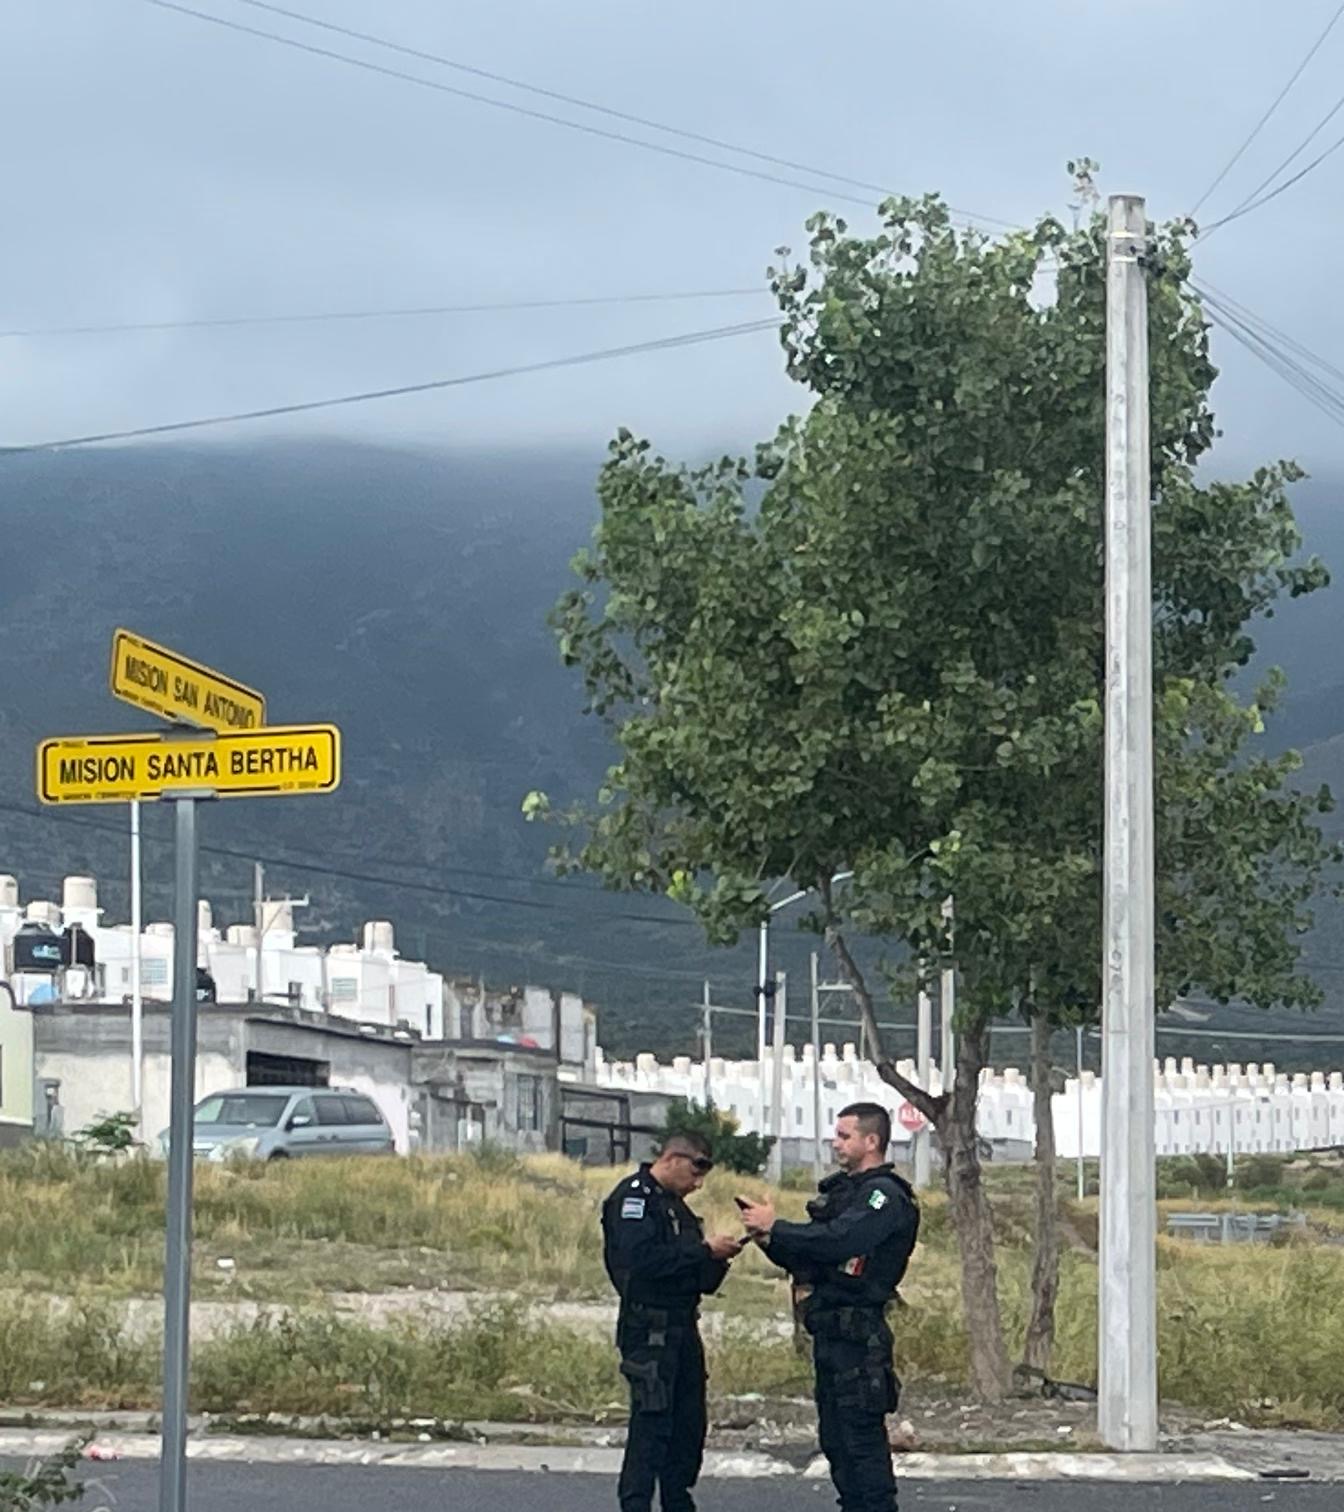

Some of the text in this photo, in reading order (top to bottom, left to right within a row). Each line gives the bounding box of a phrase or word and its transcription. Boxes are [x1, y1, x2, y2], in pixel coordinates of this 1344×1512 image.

[125, 655, 168, 695] MISION
[174, 676, 199, 708] SAN
[60, 746, 319, 784] MISION SANTA BERTHA
